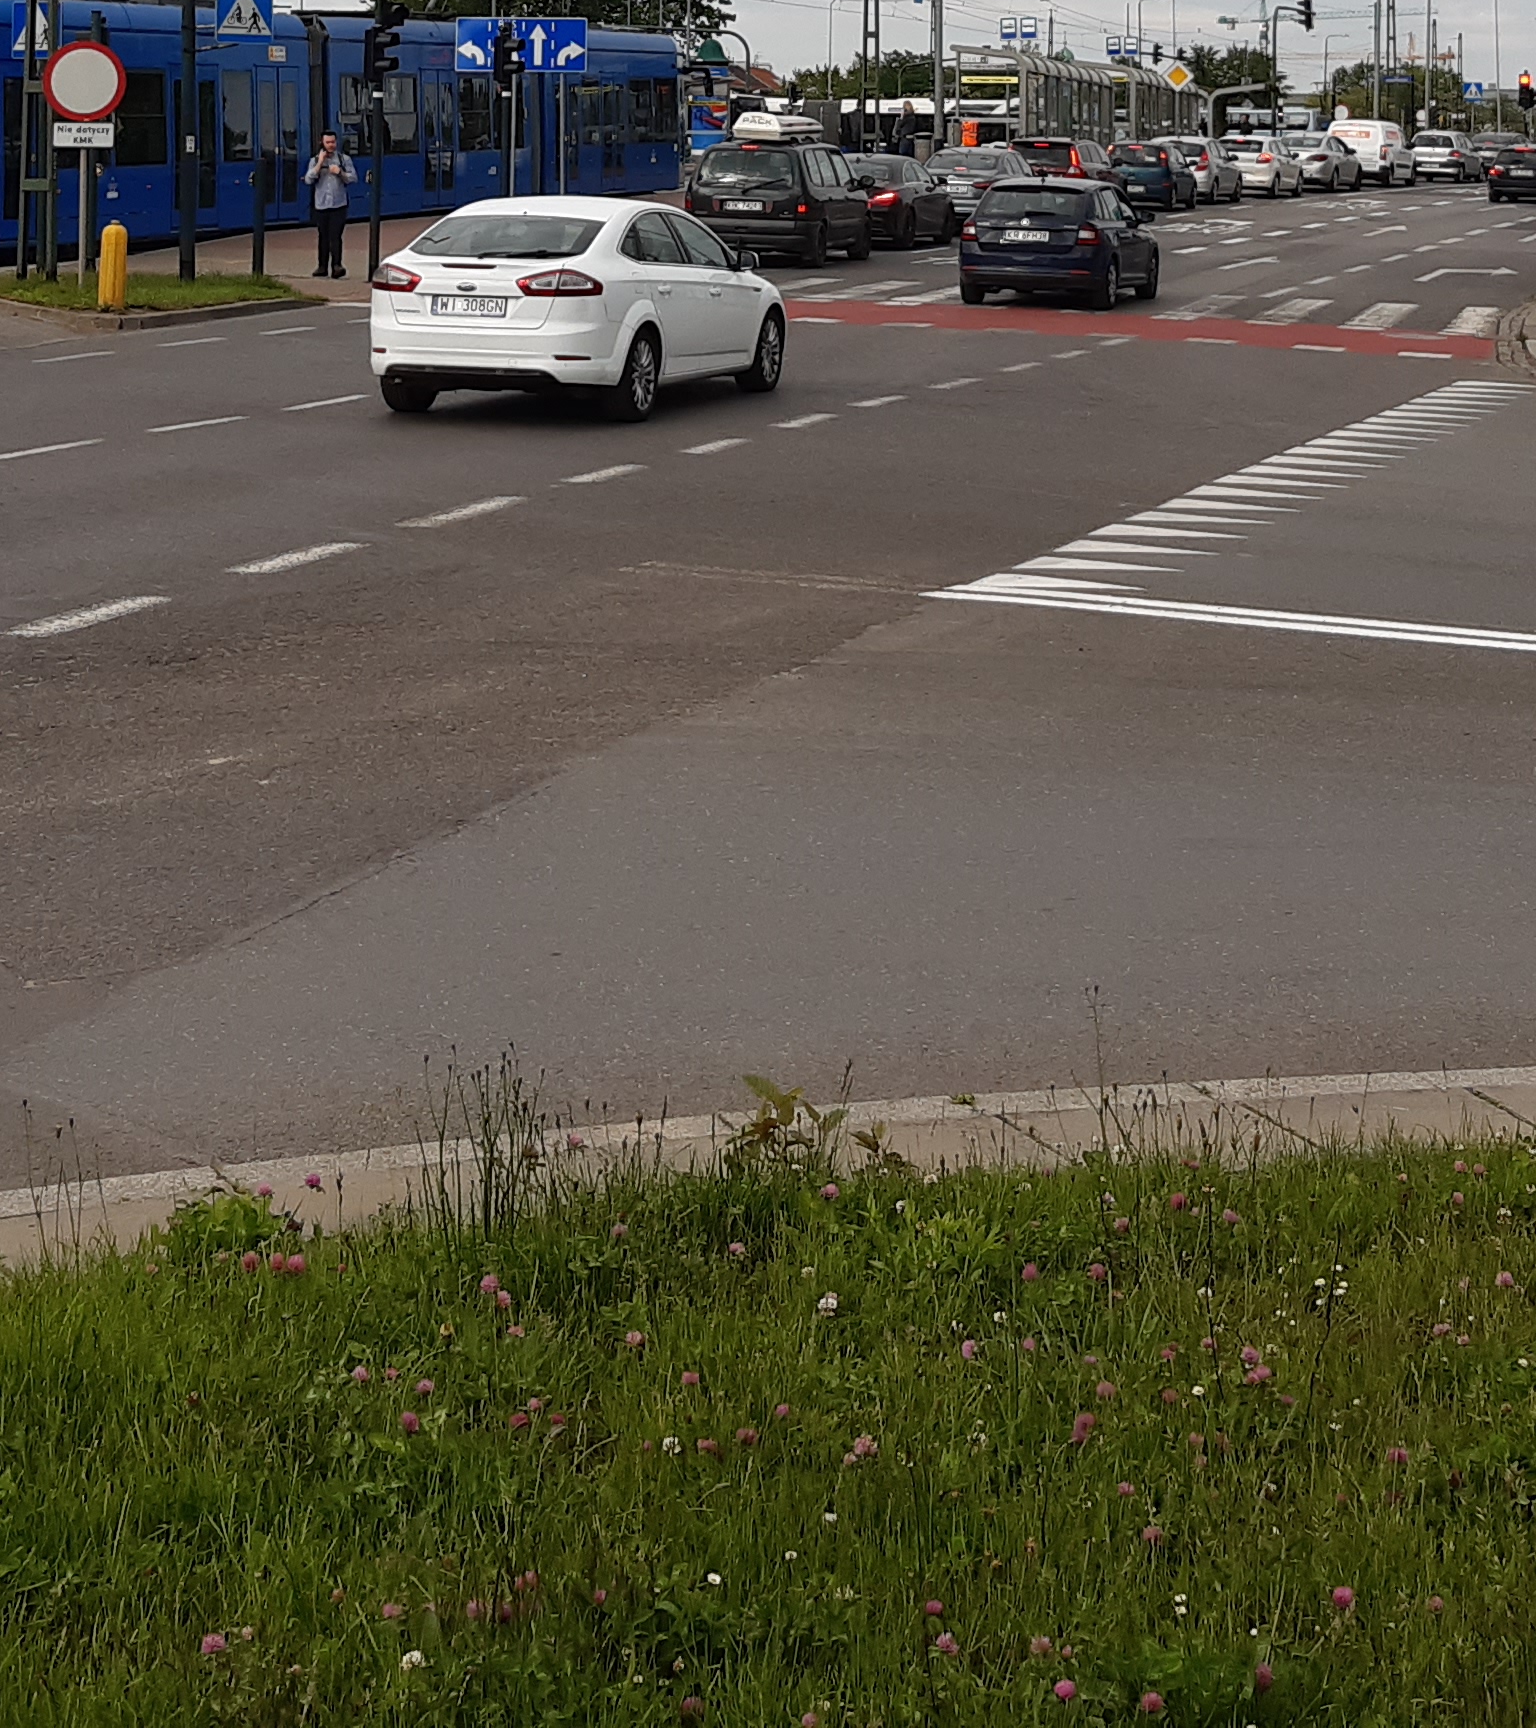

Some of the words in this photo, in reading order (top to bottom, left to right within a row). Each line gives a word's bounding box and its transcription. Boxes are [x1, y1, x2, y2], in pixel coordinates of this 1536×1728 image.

[57, 125, 73, 133] Nie
[76, 125, 110, 135] dotyczy
[440, 297, 456, 311] WI
[462, 298, 504, 312] 308GN
